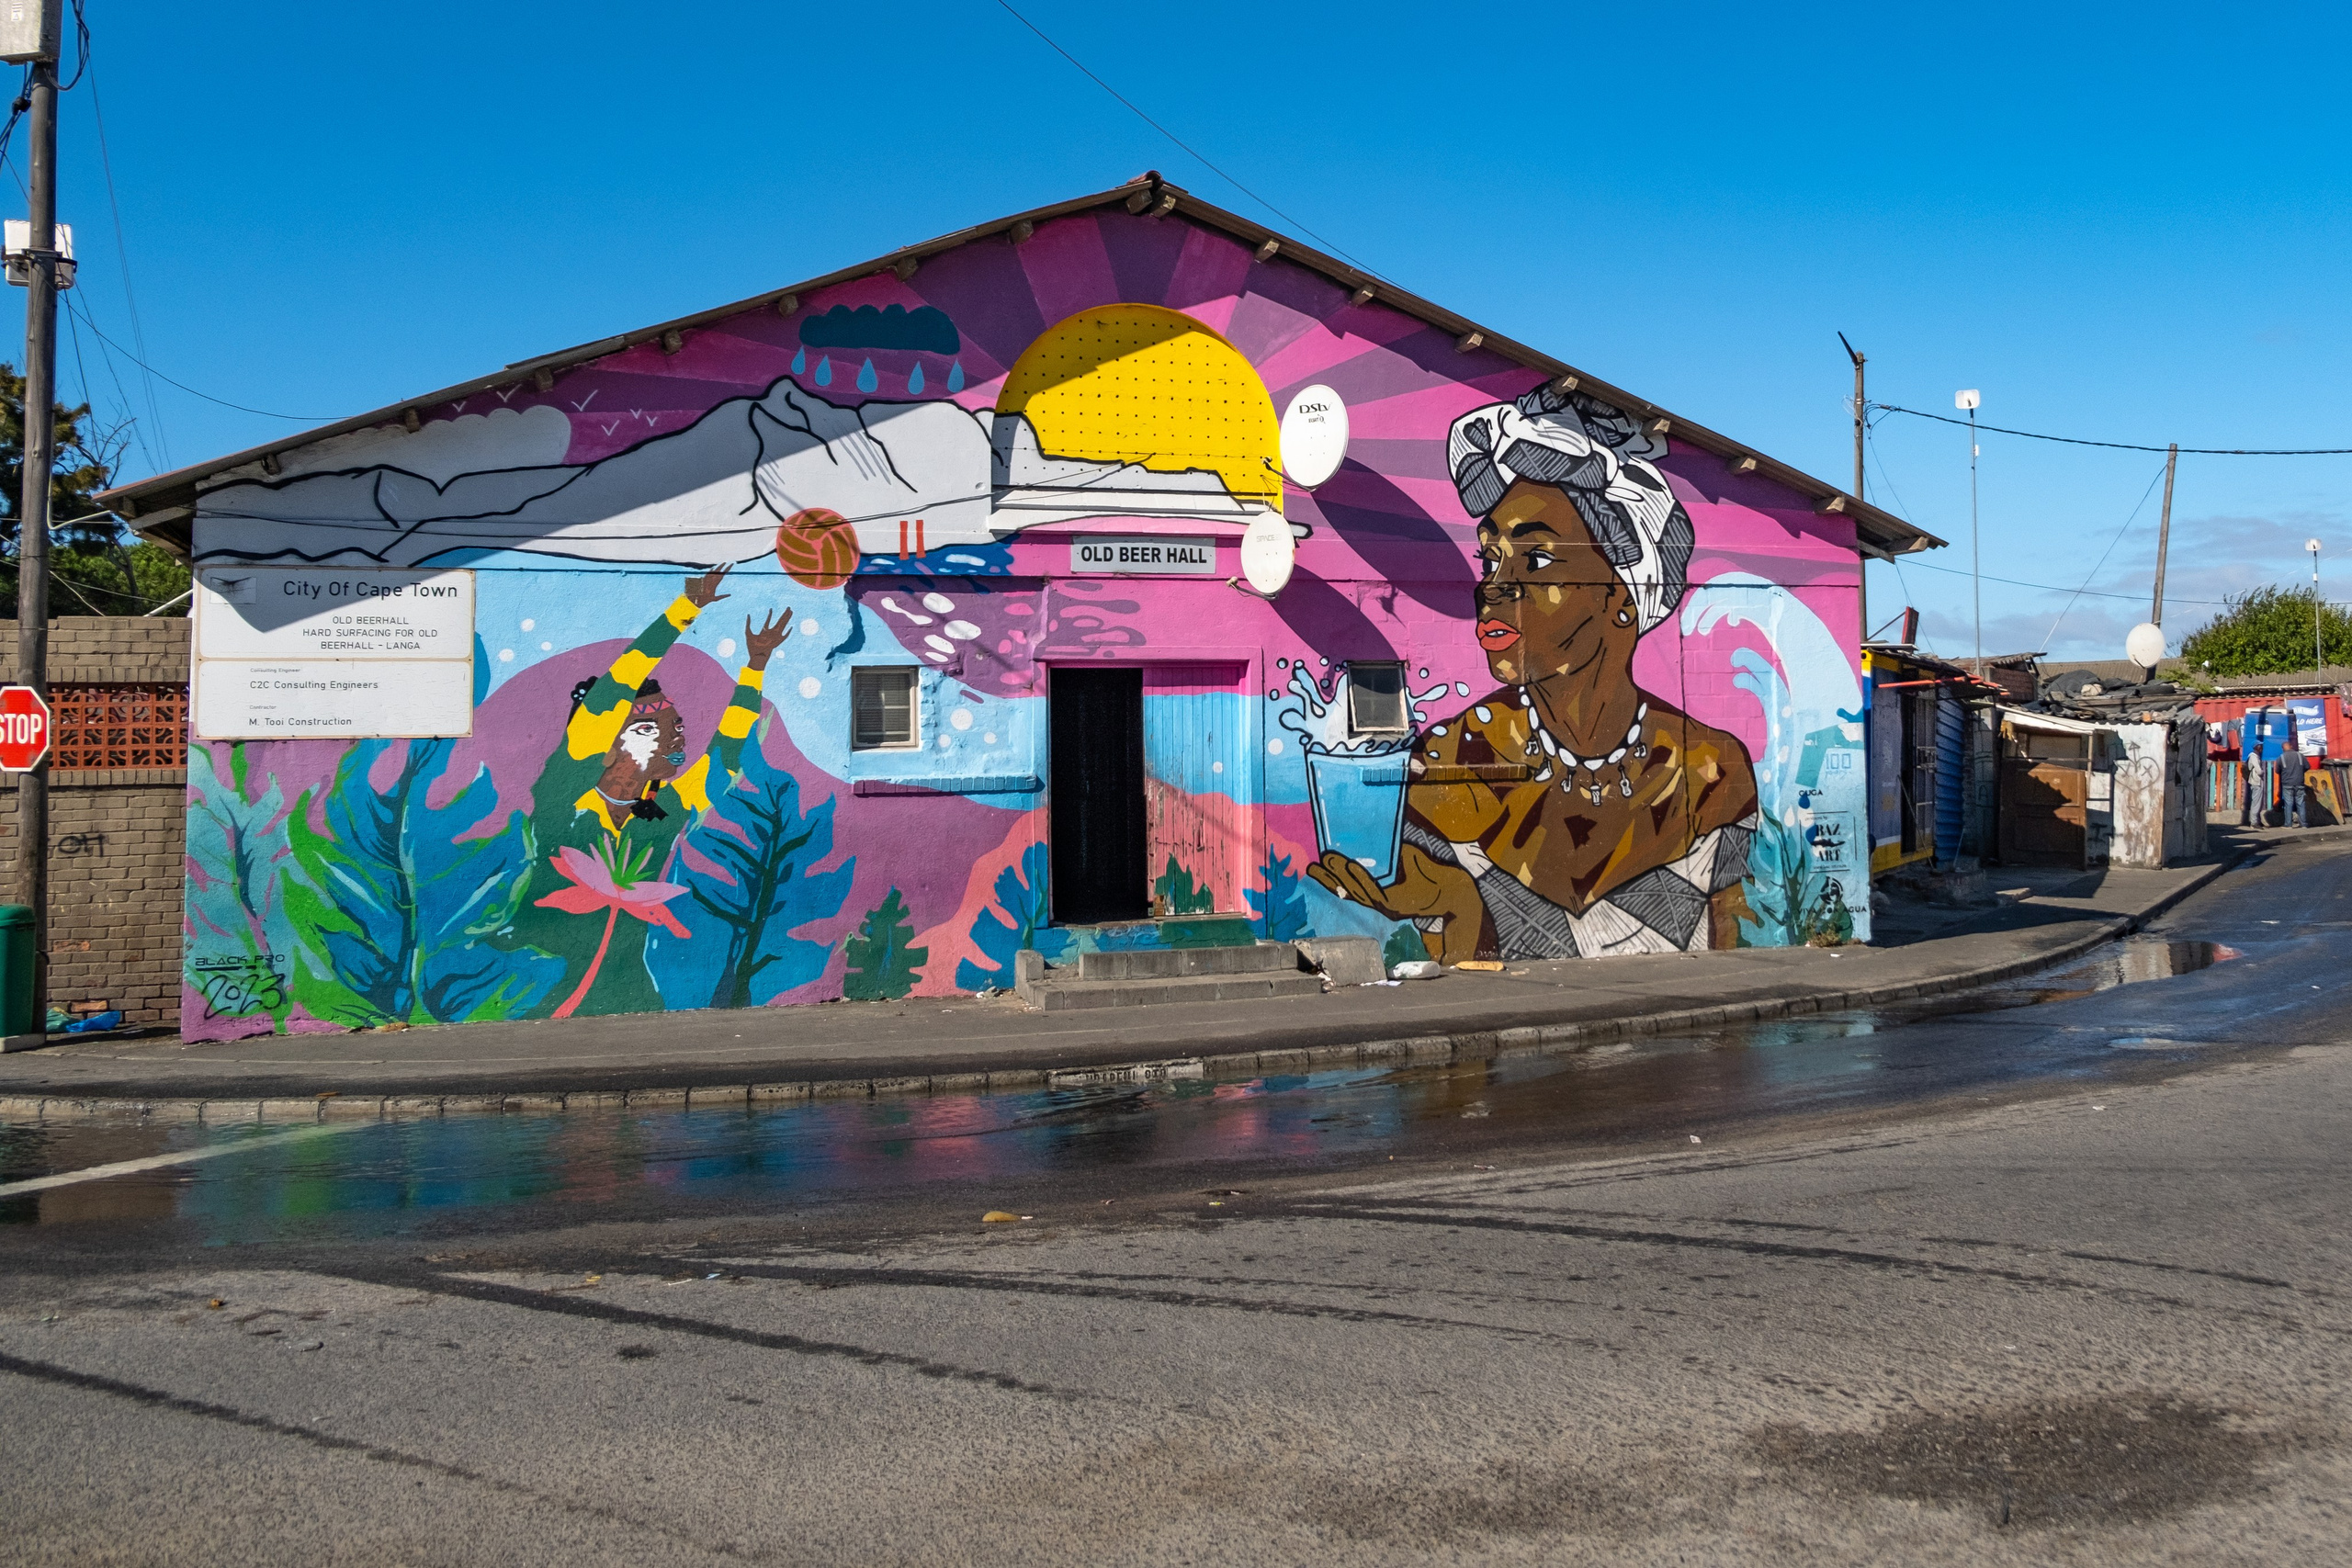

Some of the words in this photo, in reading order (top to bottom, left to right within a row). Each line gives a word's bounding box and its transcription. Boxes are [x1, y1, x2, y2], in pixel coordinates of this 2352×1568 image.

[1081, 546, 1114, 562] OLD
[1119, 547, 1161, 563] BEER
[1167, 547, 1207, 563] HALL
[284, 581, 322, 600] City
[329, 581, 349, 596] Of
[356, 581, 402, 600] Cape
[410, 582, 458, 597] Town
[333, 615, 353, 625] OLD
[356, 616, 410, 625] BEERHALL
[302, 628, 332, 637] HARD
[335, 628, 391, 637] SURFACING
[418, 629, 438, 637] OLD
[321, 641, 374, 649] BEERHALL
[250, 681, 270, 689] C2C
[274, 681, 326, 691] Consulting
[330, 681, 379, 691] Engineers
[248, 717, 260, 726] M.
[265, 717, 284, 726] Tooi
[288, 717, 352, 726] Construction
[1816, 823, 1841, 836] BAZ
[1816, 849, 1843, 862] ART
[195, 955, 248, 966] BLACK
[201, 973, 286, 1020] 2023
